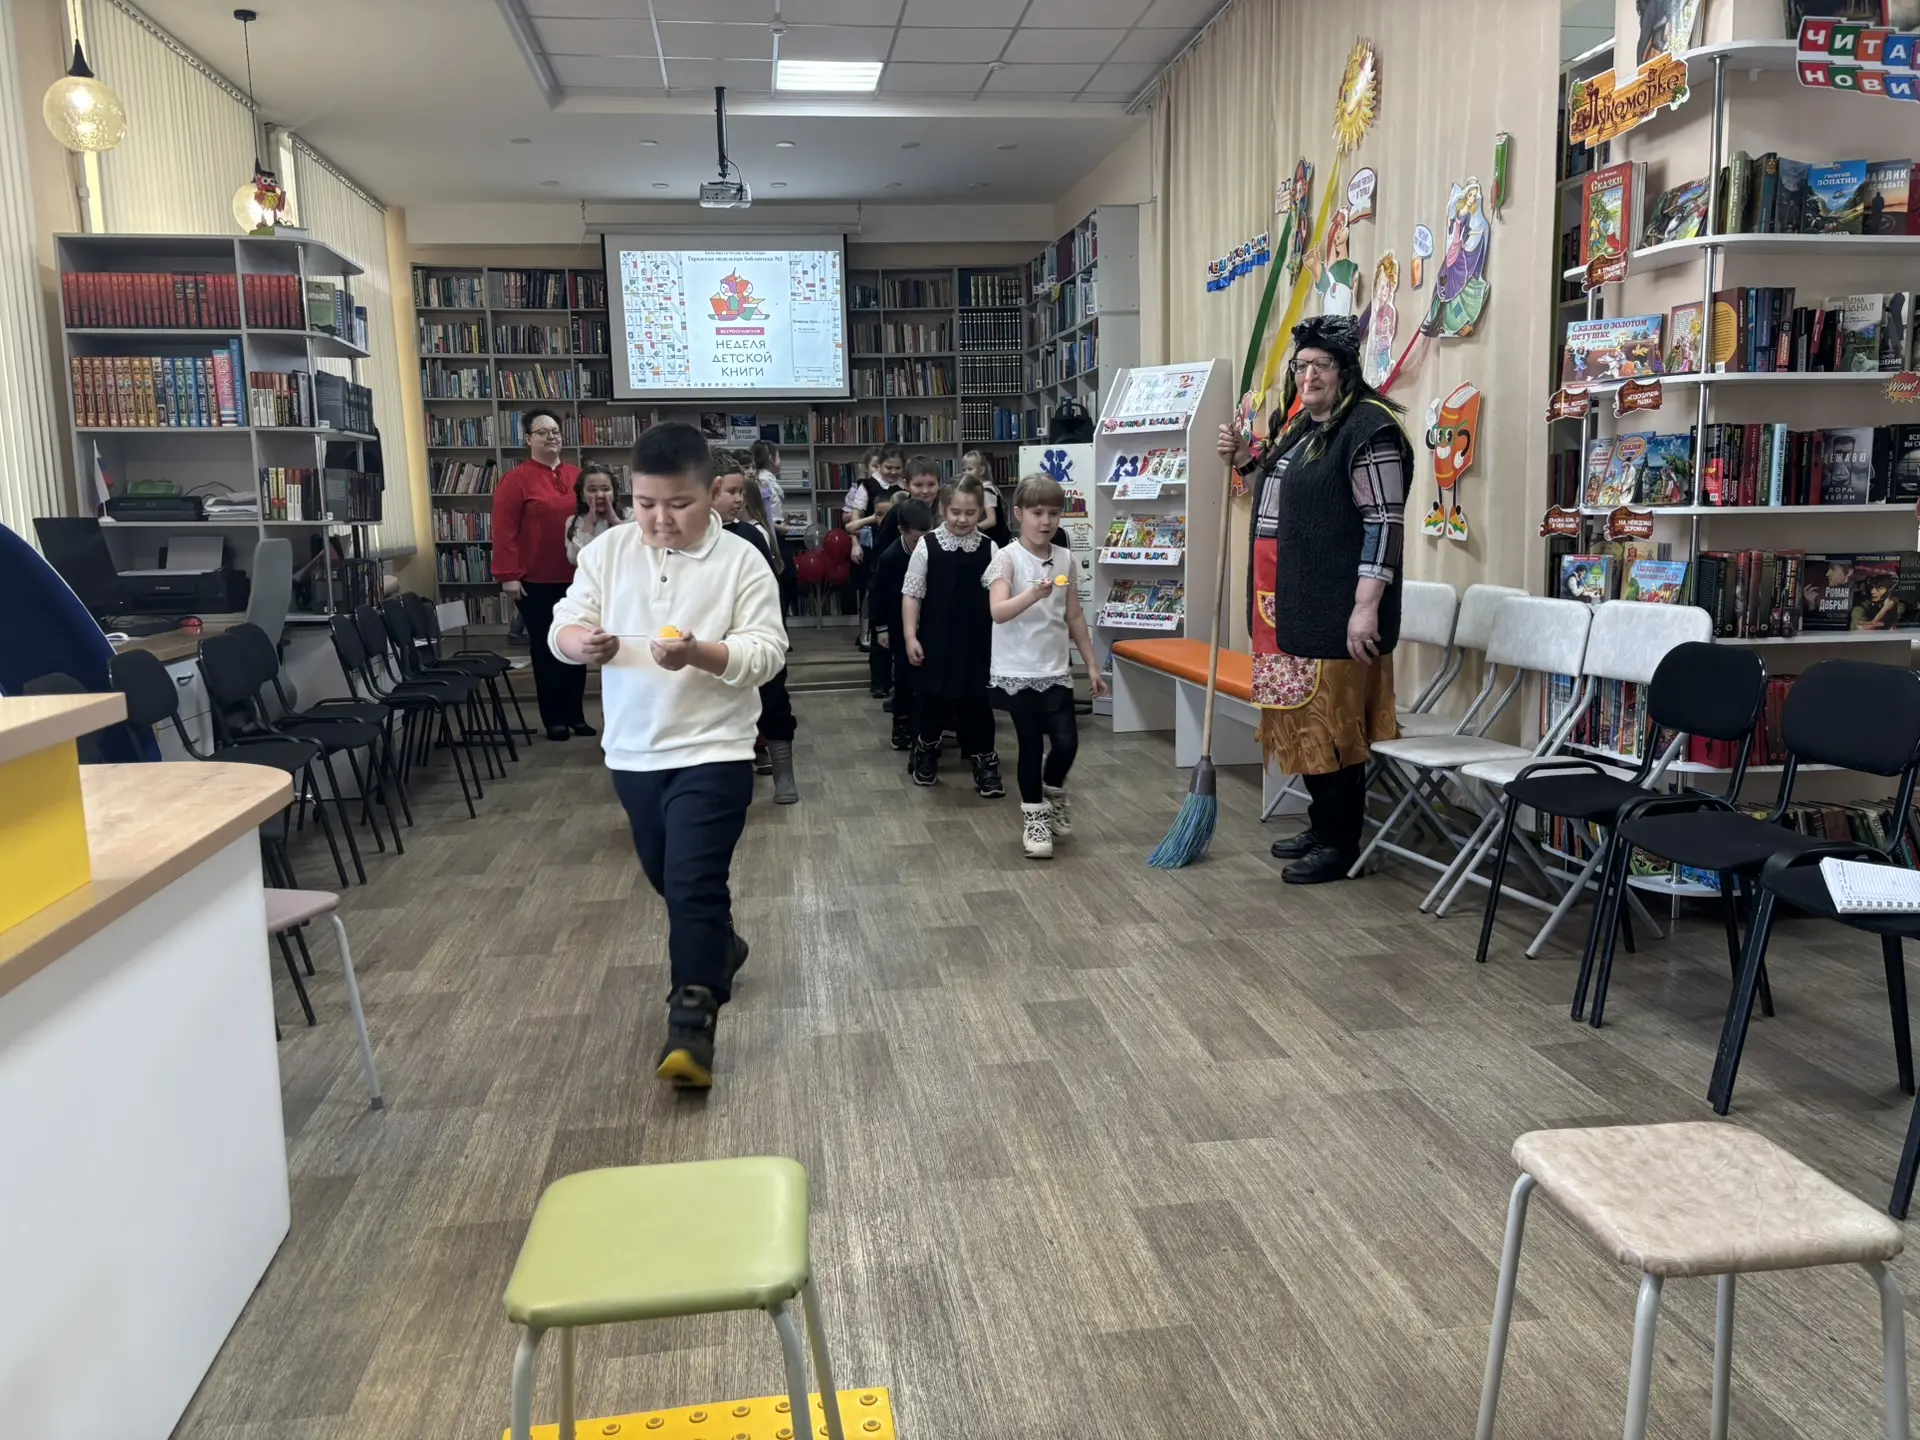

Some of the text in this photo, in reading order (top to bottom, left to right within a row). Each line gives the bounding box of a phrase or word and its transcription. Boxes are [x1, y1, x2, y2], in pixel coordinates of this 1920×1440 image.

[1807, 29, 1920, 64] ЧИТА
[1805, 70, 1920, 95] НОВИ
[1572, 63, 1680, 141] Лукоморье
[1817, 177, 1858, 187] ЛОПАТИН
[1572, 319, 1648, 333] Сказка о золотом
[1571, 330, 1611, 341] петушке
[716, 339, 766, 349] НЕДЕЛЯ
[711, 351, 773, 364] ДЕТСКОЙ
[721, 367, 764, 377] КНИГИ
[1825, 587, 1850, 599] РОМАН
[1819, 598, 1849, 612] ДОБРЫЙ
